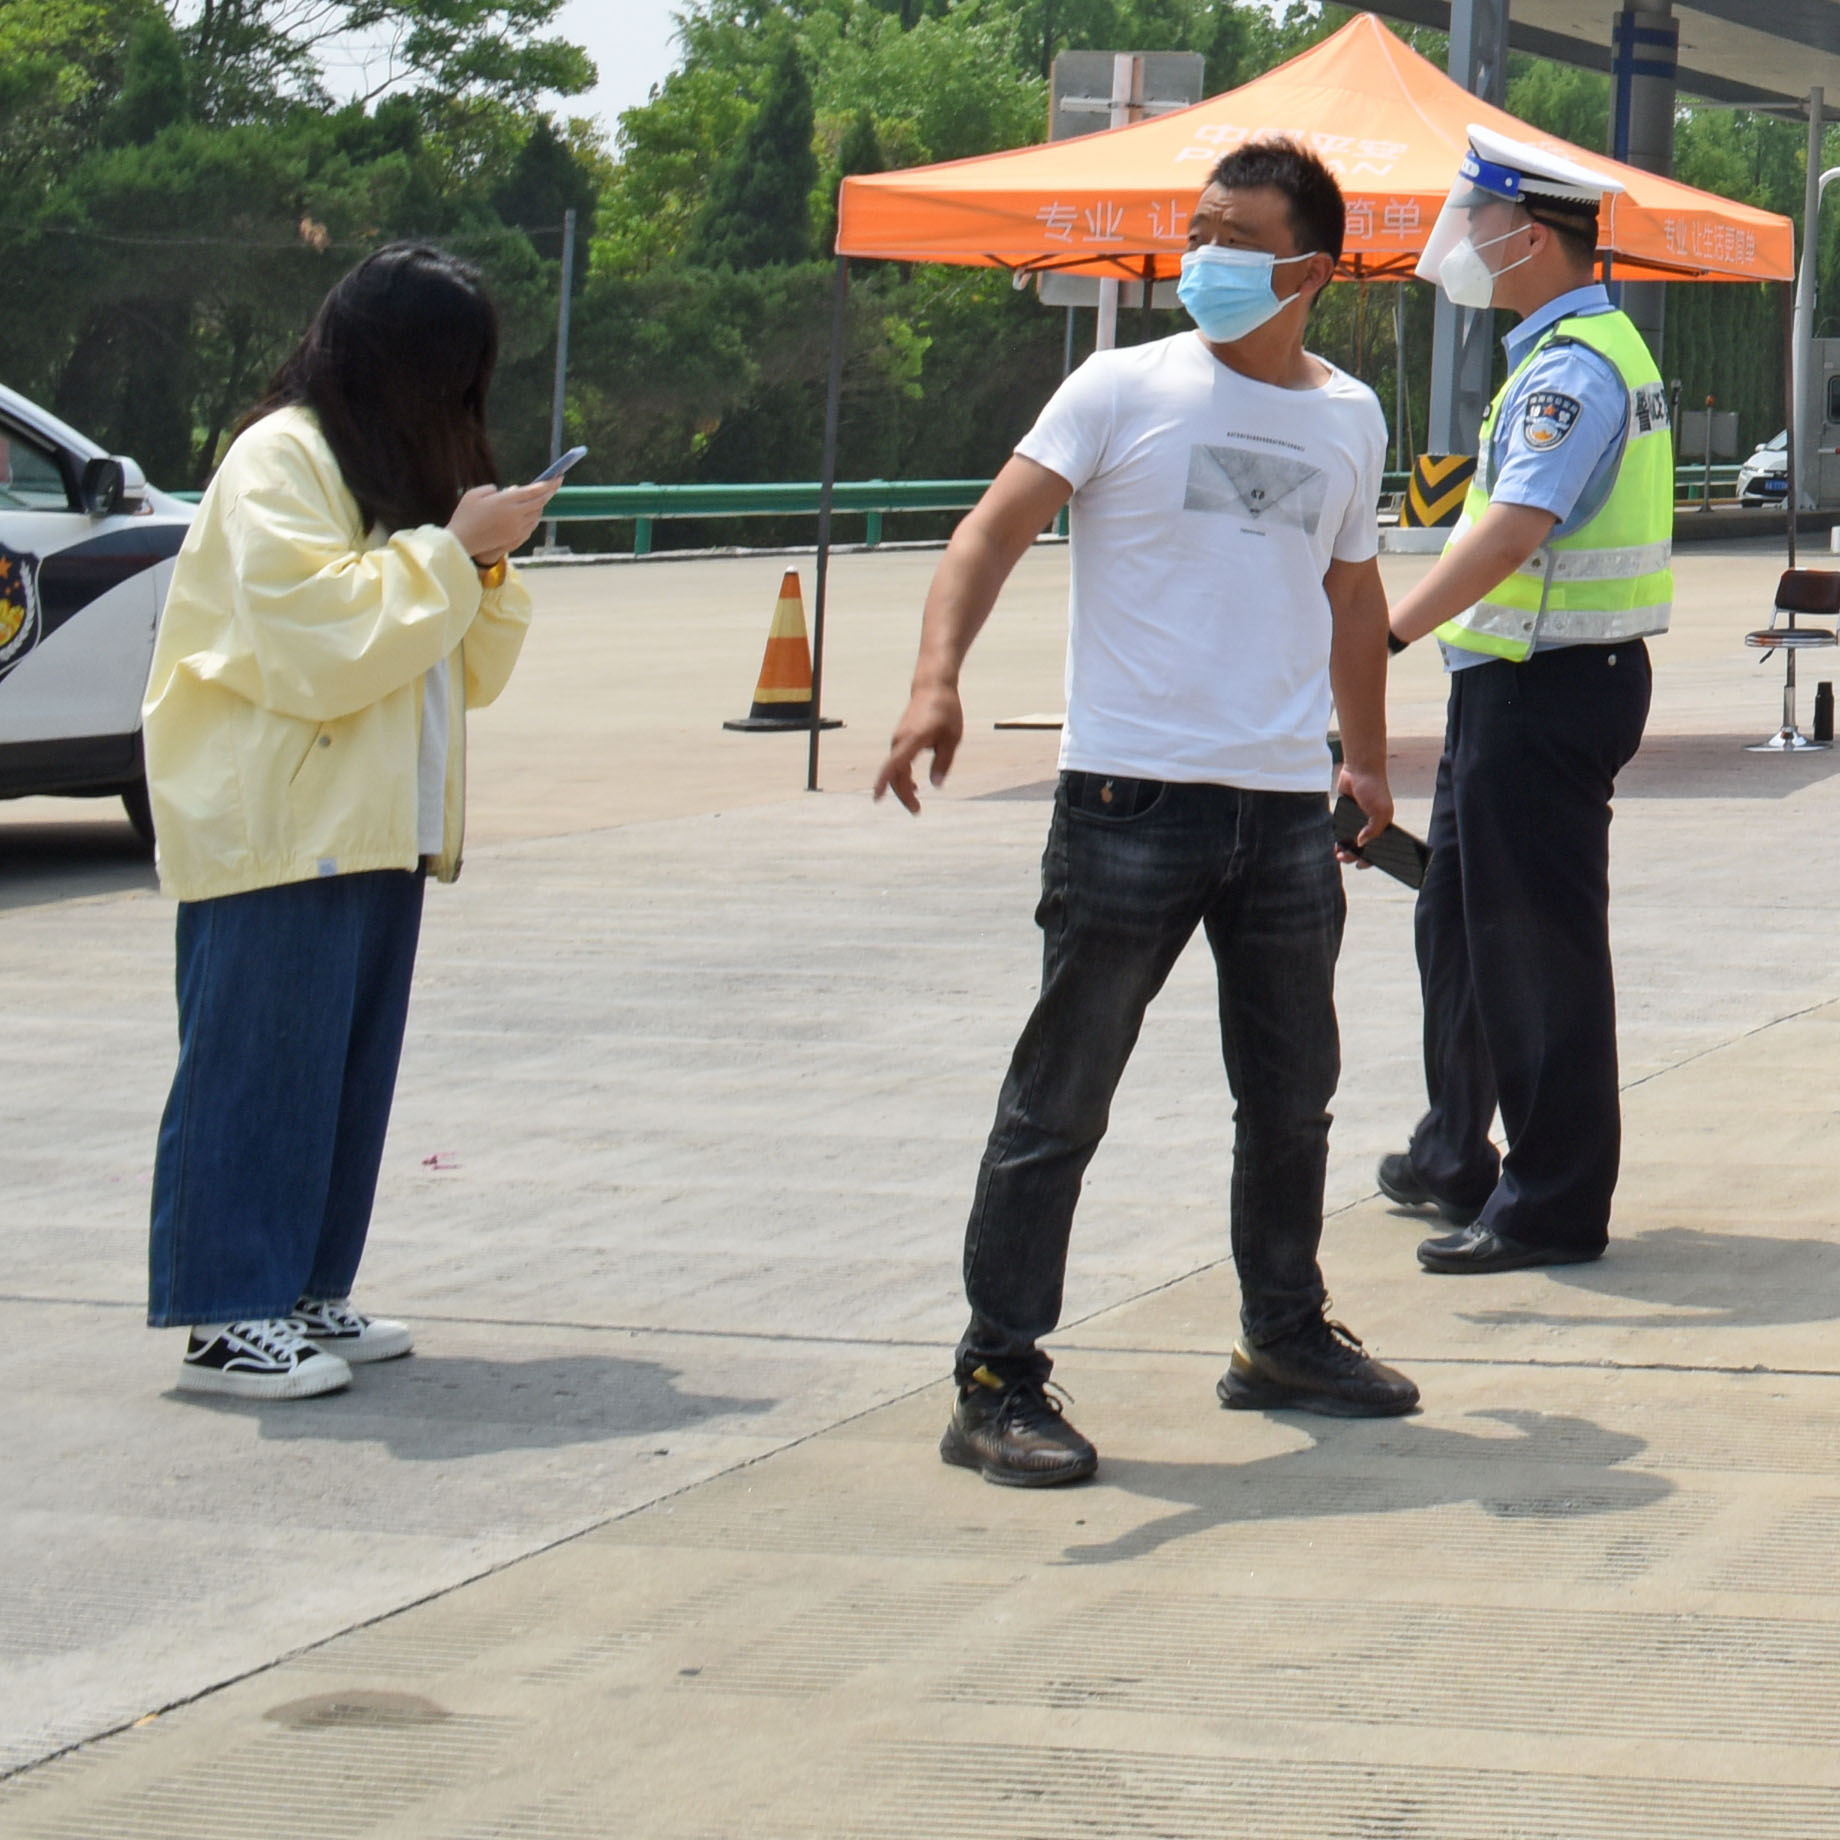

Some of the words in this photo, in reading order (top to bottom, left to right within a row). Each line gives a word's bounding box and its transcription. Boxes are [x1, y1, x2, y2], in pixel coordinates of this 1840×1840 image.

[1035, 200, 1125, 244] 专业
[1663, 216, 1689, 258] 专业
[1690, 219, 1756, 265] 让生活更简单
